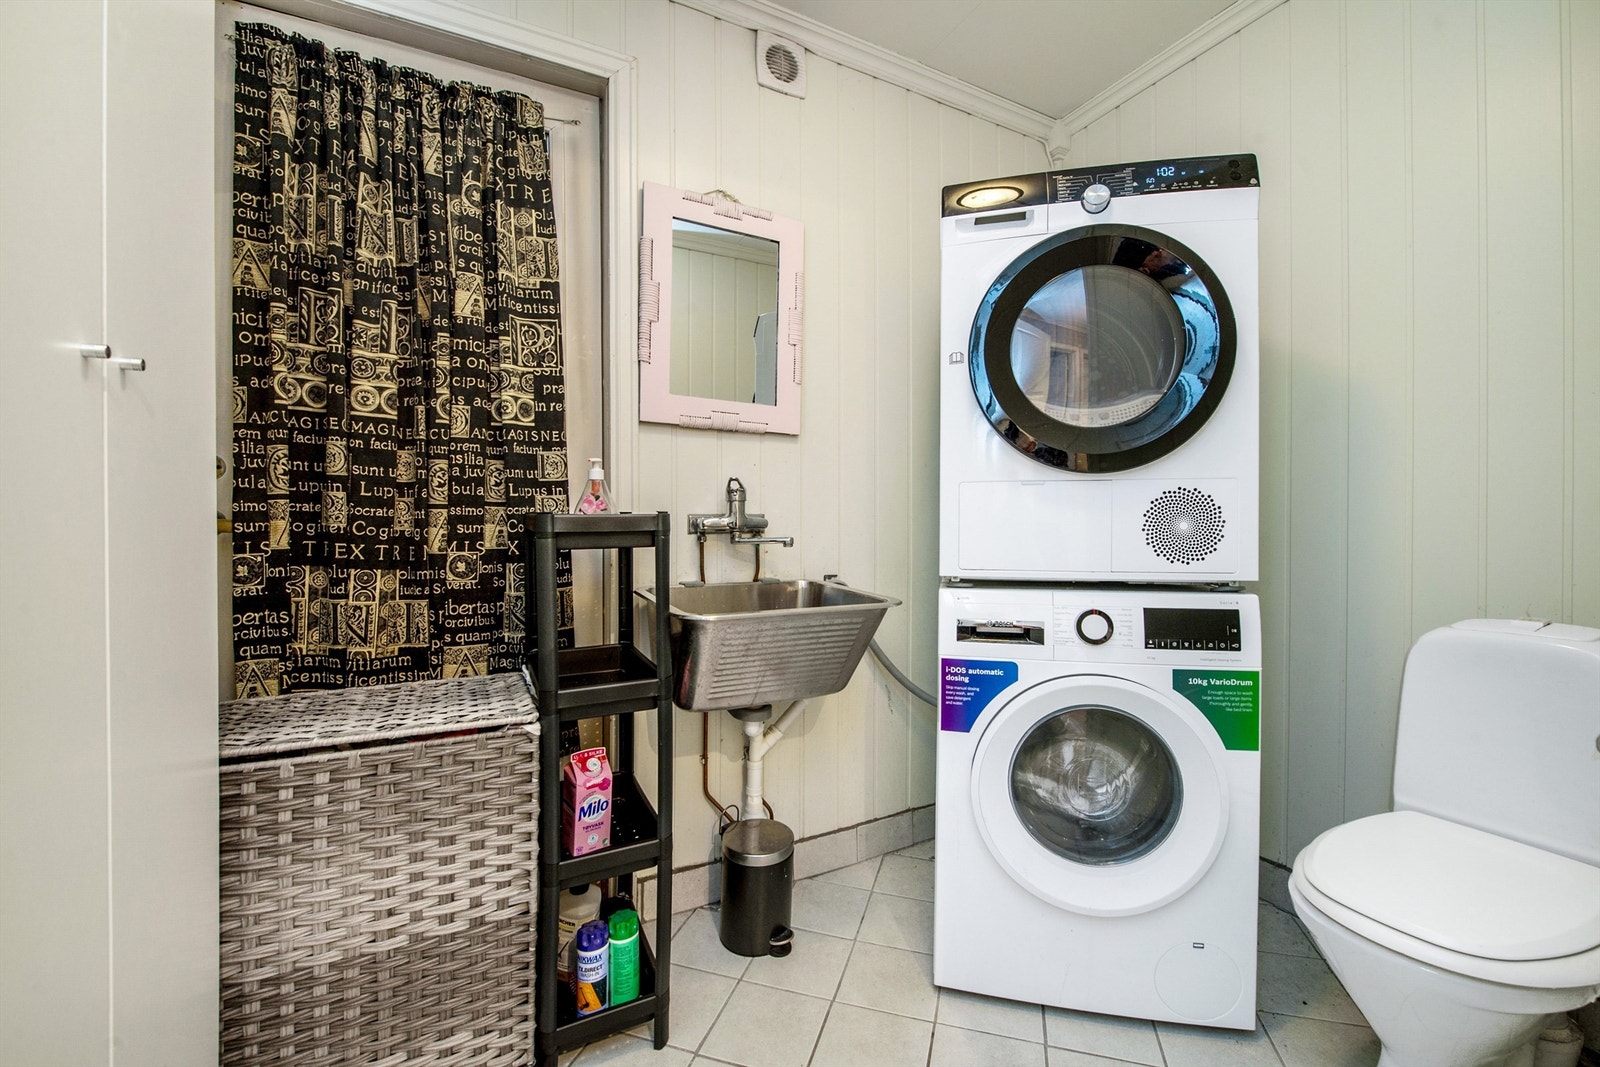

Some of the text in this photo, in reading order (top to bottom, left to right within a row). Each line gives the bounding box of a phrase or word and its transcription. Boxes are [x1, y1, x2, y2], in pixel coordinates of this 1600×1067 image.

[235, 61, 267, 78] ula
[968, 668, 1004, 676] automatic
[945, 674, 970, 683] dosing
[1188, 677, 1253, 686] 10kg VarioDrum
[578, 798, 609, 823] Milo
